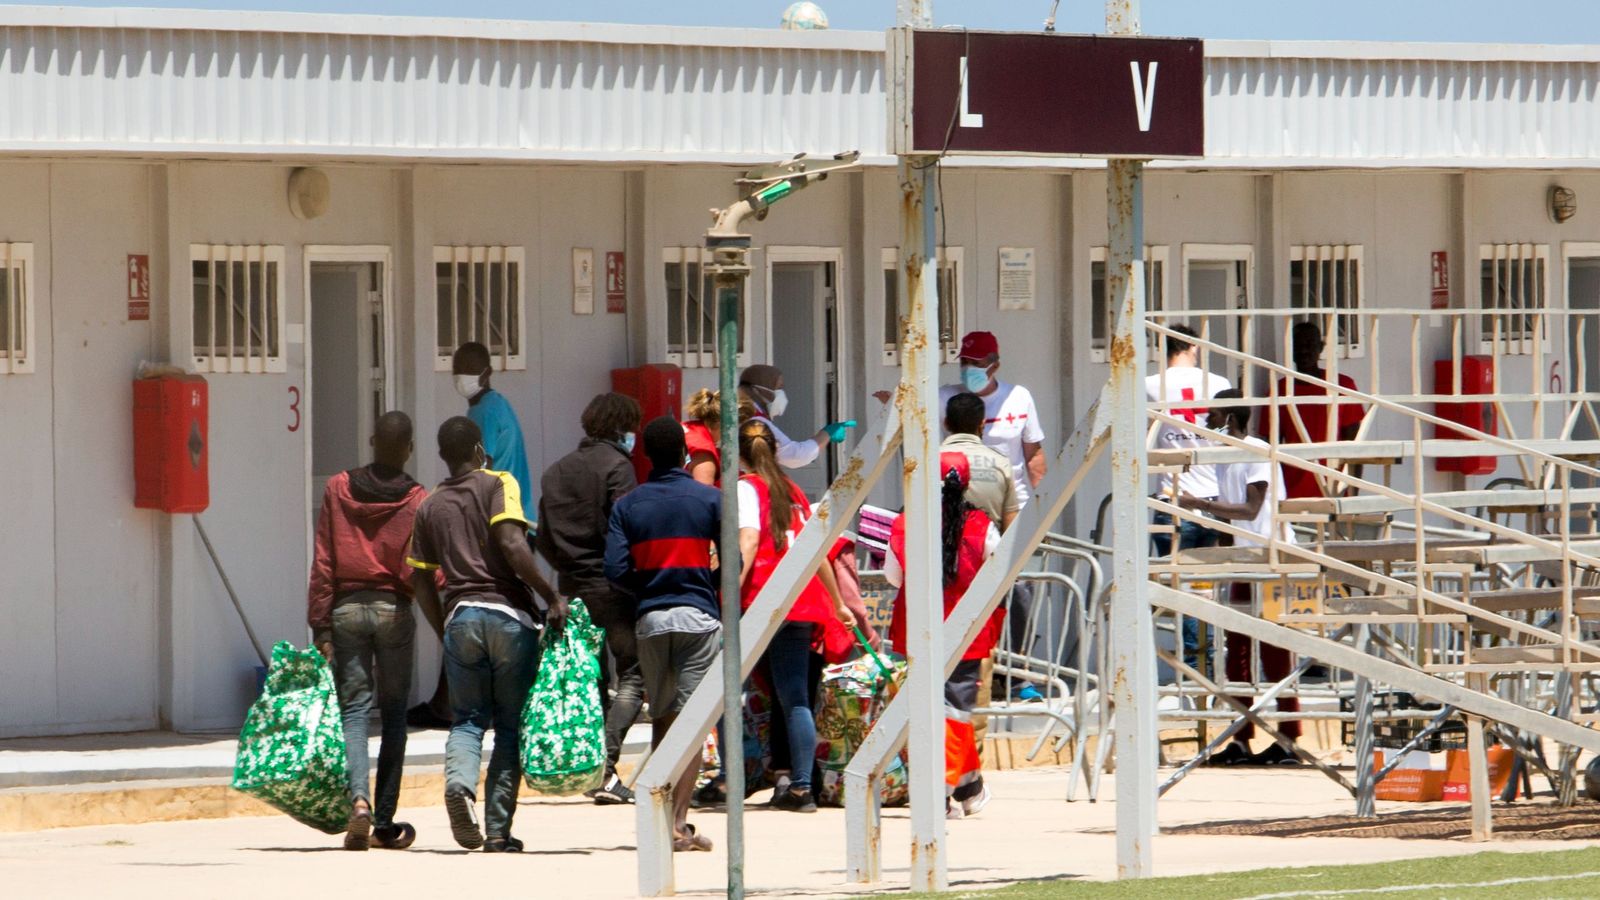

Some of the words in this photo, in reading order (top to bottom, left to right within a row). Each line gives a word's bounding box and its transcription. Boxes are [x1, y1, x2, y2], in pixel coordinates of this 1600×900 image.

[959, 56, 983, 128] L
[1130, 61, 1158, 132] V
[1549, 360, 1562, 394] 6
[287, 385, 300, 432] 3
